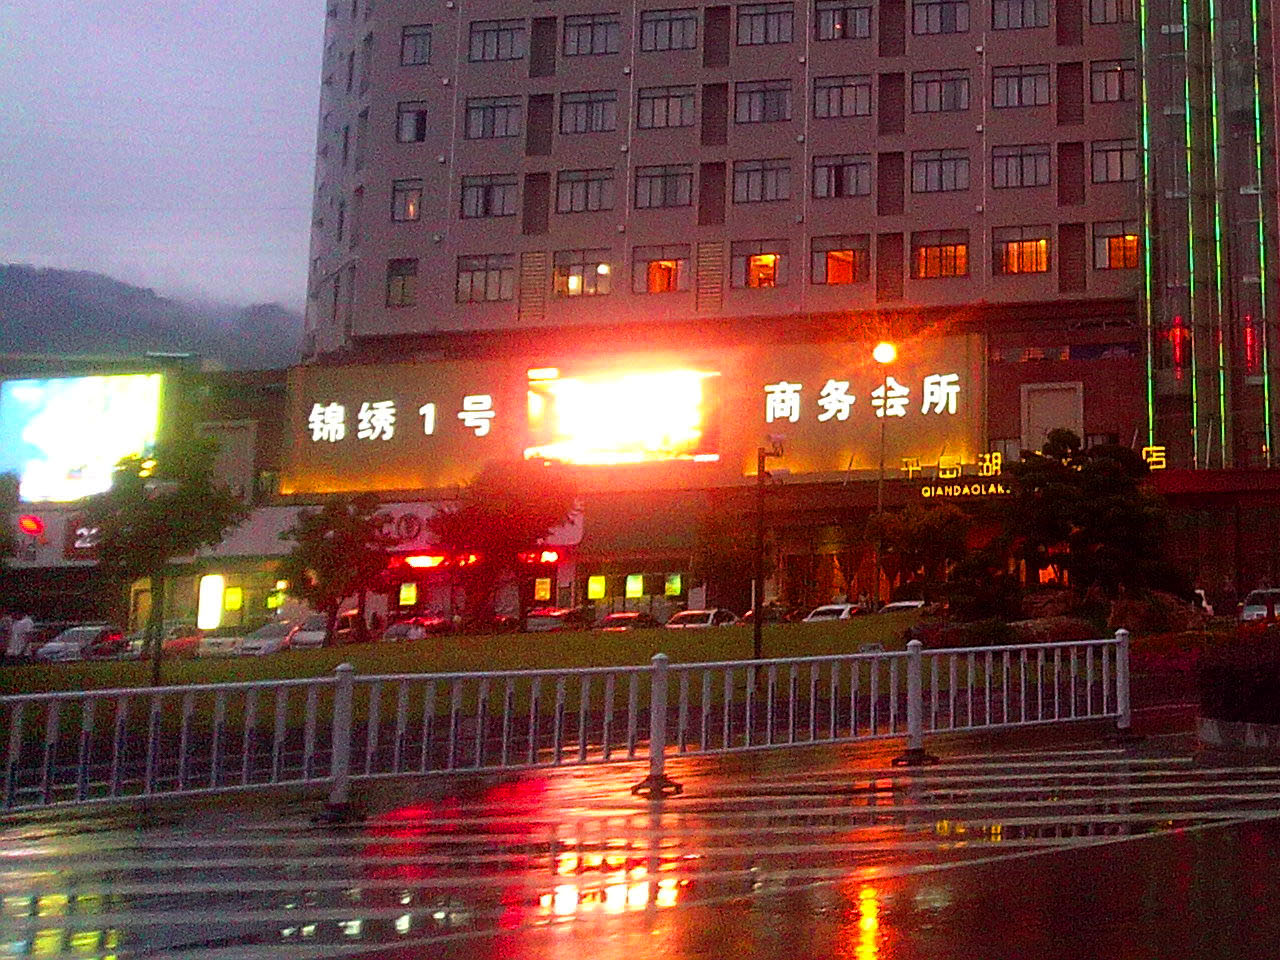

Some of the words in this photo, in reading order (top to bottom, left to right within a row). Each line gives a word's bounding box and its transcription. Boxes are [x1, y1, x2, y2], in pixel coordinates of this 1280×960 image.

[307, 393, 497, 443] 锦绣1号
[764, 373, 961, 424] 商务会所
